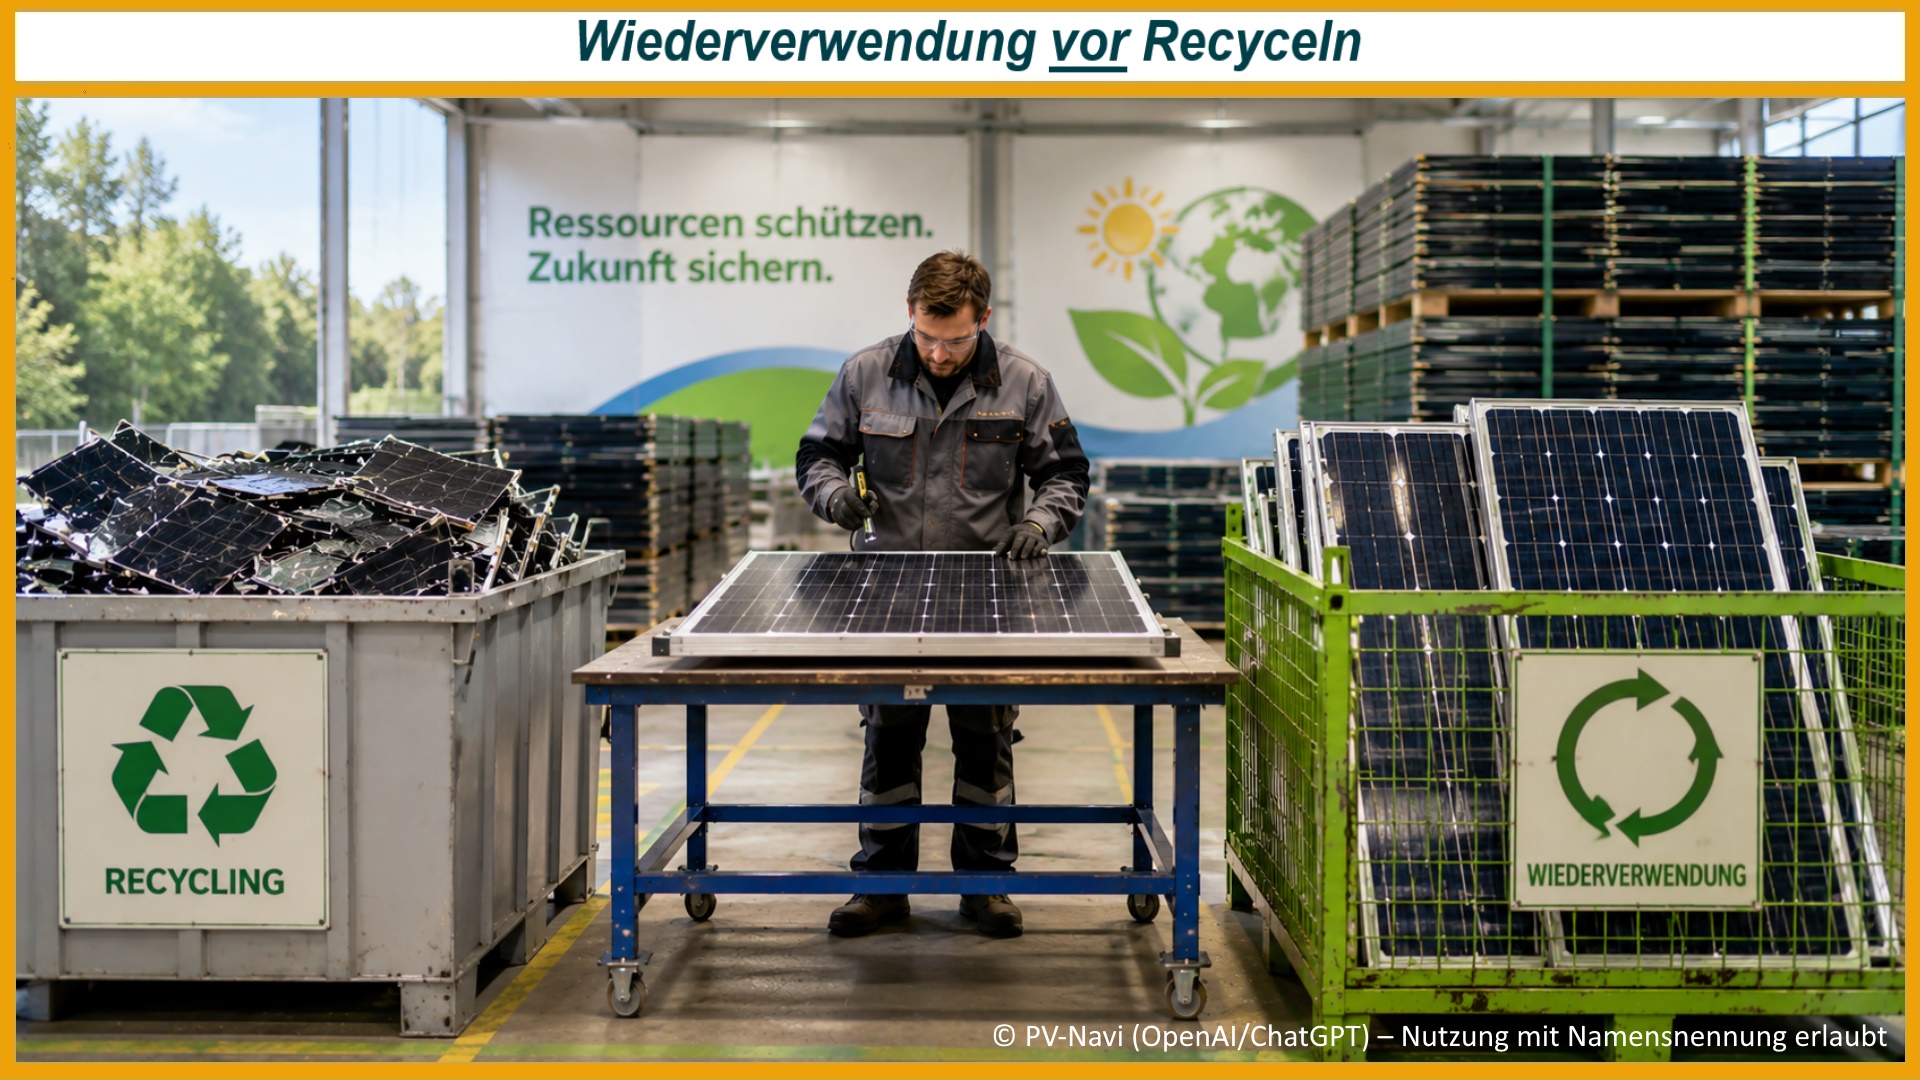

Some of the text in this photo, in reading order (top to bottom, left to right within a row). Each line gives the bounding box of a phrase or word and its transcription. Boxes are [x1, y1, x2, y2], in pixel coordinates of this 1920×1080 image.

[528, 205, 934, 239] Ressourcen schützen.
[528, 251, 834, 284] Zukunft sichern.
[104, 867, 286, 896] RECYCLING
[1527, 861, 1747, 888] WIEDERVERWENDUNG
